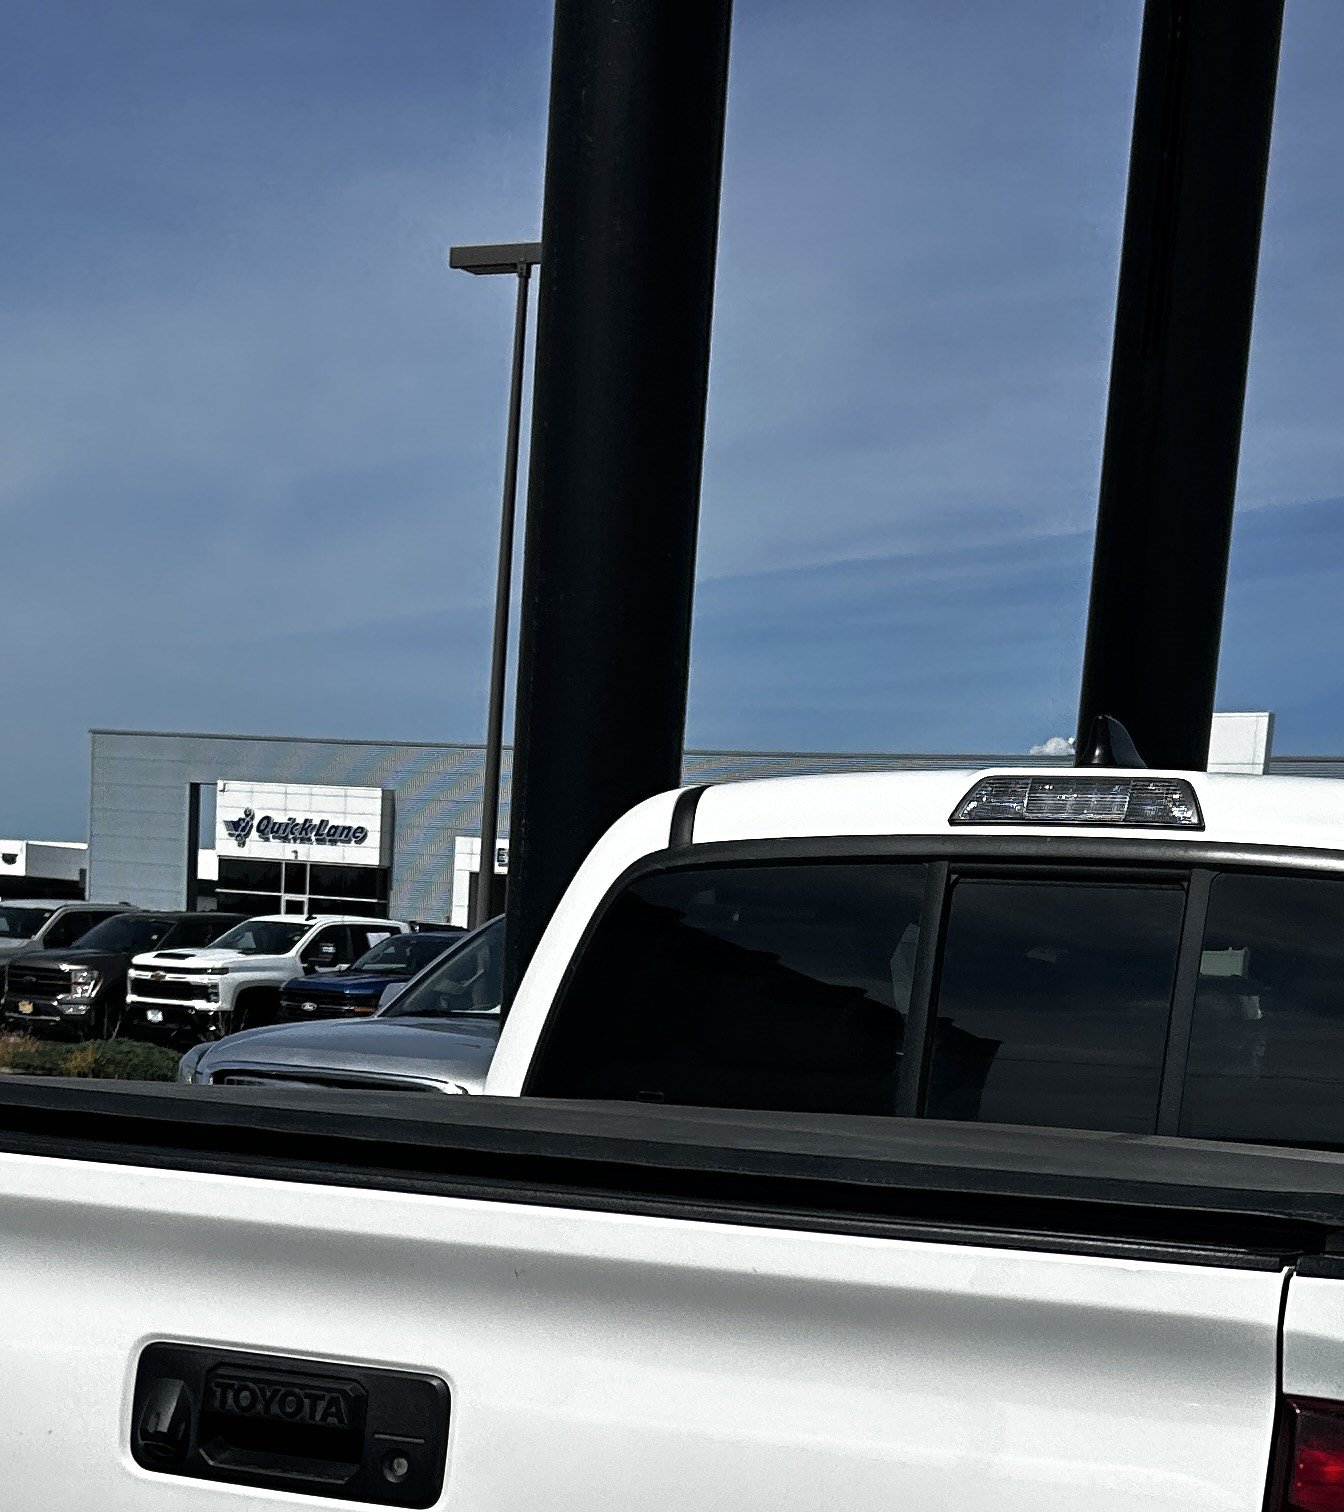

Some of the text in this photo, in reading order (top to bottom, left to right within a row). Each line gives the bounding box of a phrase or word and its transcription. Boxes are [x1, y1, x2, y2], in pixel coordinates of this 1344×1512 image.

[256, 816, 368, 843] Quick Lane
[212, 1379, 350, 1425] TOYOTA
